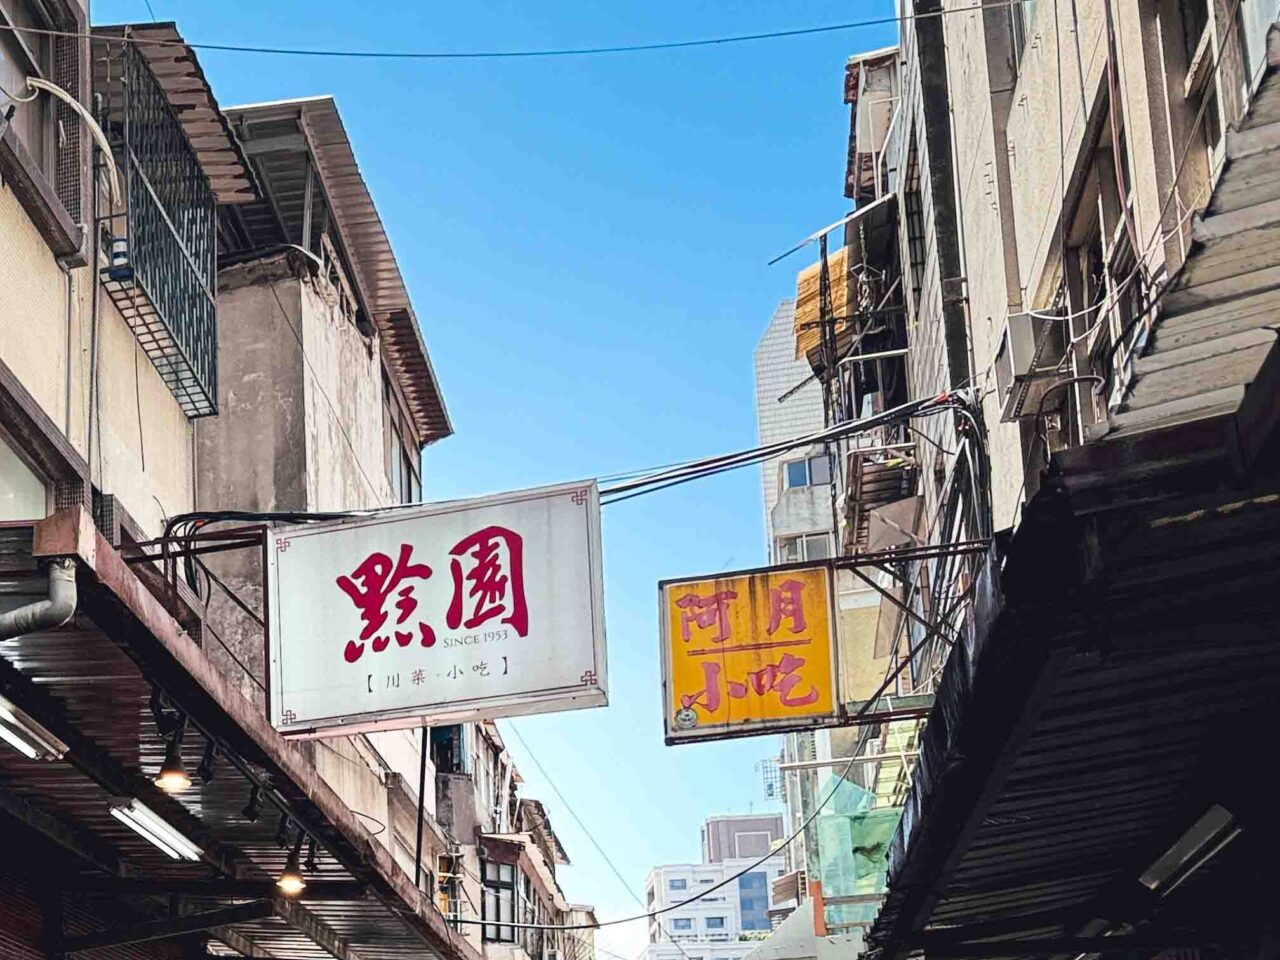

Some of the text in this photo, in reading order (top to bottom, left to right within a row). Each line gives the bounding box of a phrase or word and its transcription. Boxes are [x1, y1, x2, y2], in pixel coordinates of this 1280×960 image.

[336, 526, 528, 663] 黔園
[676, 579, 807, 643] 阿月
[443, 629, 508, 648] SINCE 1953
[681, 653, 819, 712] 小吃
